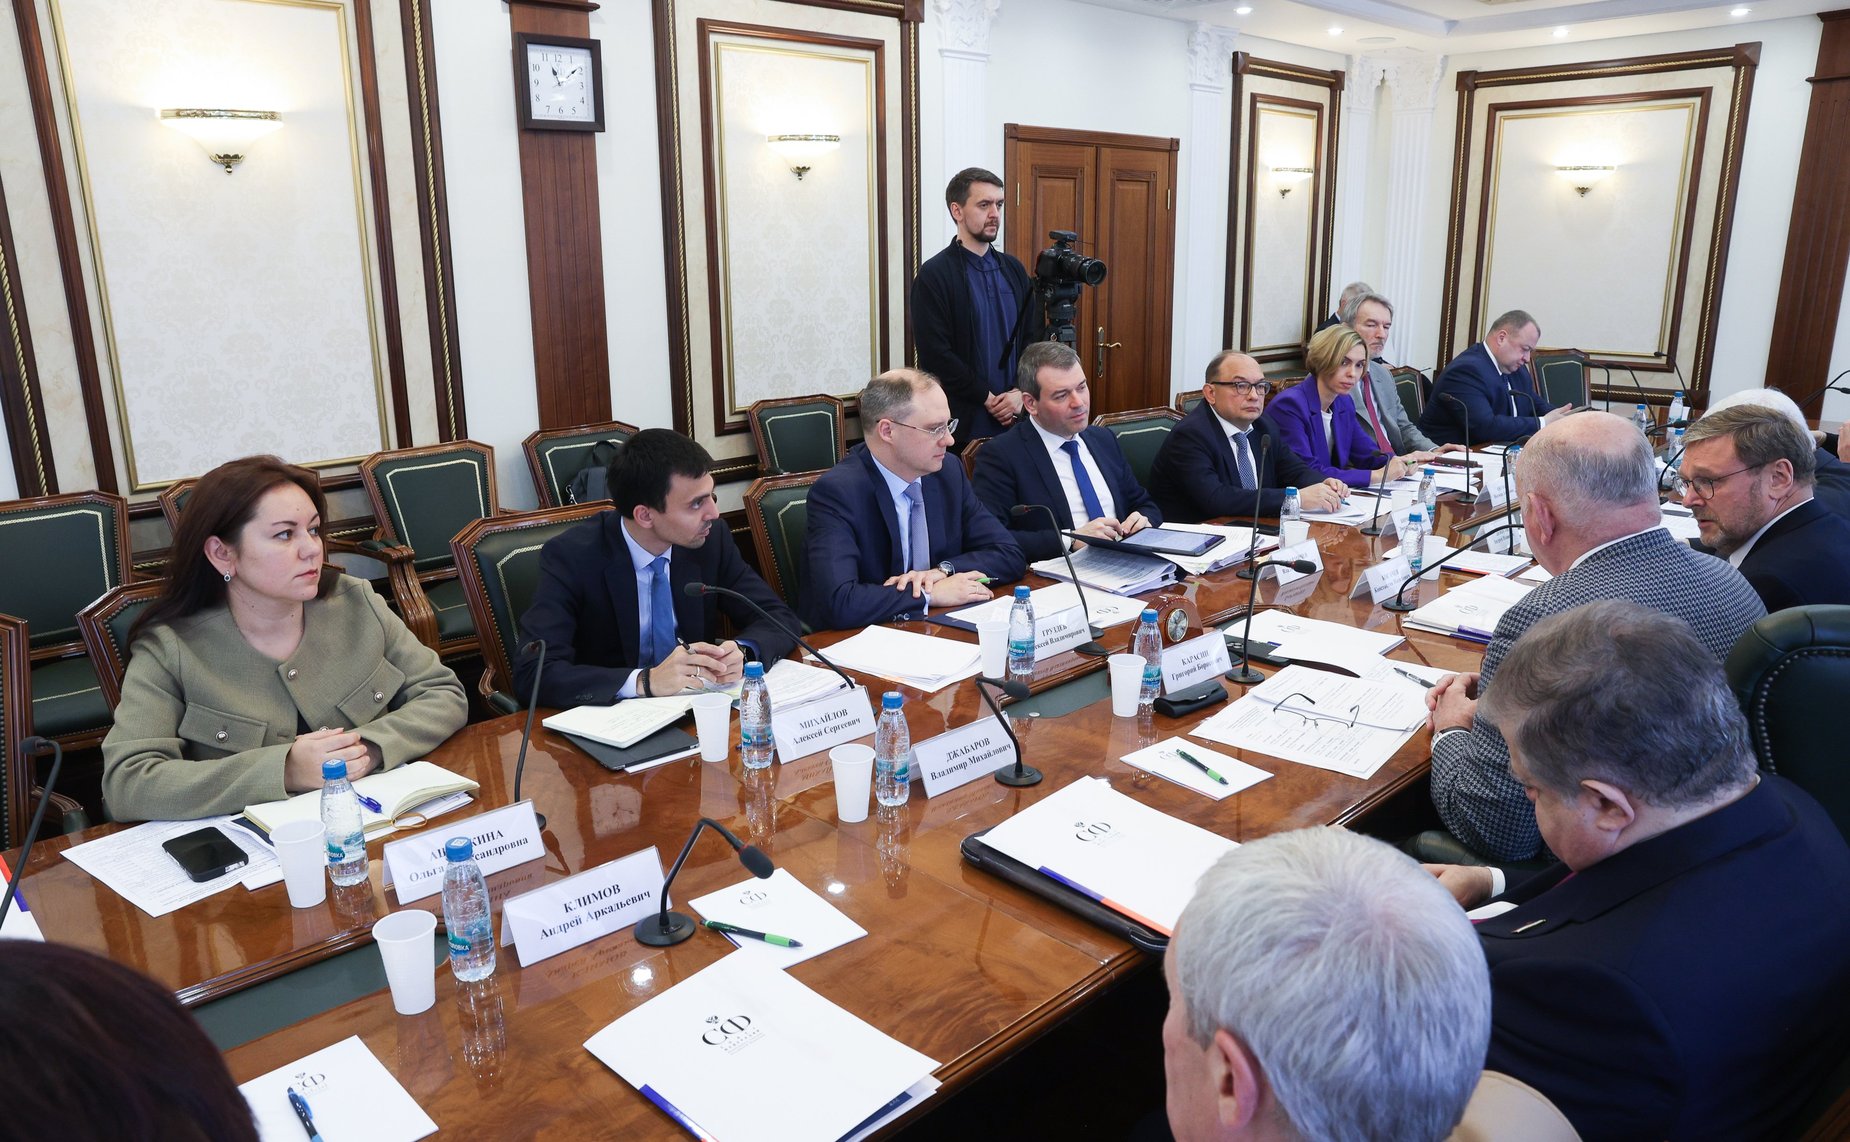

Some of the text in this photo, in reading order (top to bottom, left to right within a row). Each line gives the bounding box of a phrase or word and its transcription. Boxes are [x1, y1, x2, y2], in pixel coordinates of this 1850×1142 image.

[541, 52, 549, 62] 11
[554, 54, 562, 63] 12
[532, 63, 540, 72] 10
[533, 79, 540, 87] 9
[579, 81, 584, 90] 3
[535, 94, 541, 102] 8
[579, 96, 585, 105] 4
[545, 105, 551, 114] 7
[558, 106, 564, 115] 6
[571, 106, 577, 115] 5
[799, 708, 848, 730] МИХАЙЛОВ
[793, 717, 861, 745] Алексей Сергеевич
[946, 737, 990, 762] ДЖАБАРОВ
[930, 743, 1012, 781] Владимир Михайлович
[409, 836, 529, 882] Ольга сандровна
[563, 883, 621, 913] КЛИМОВ
[540, 890, 651, 940] Андрей Аркадьевич
